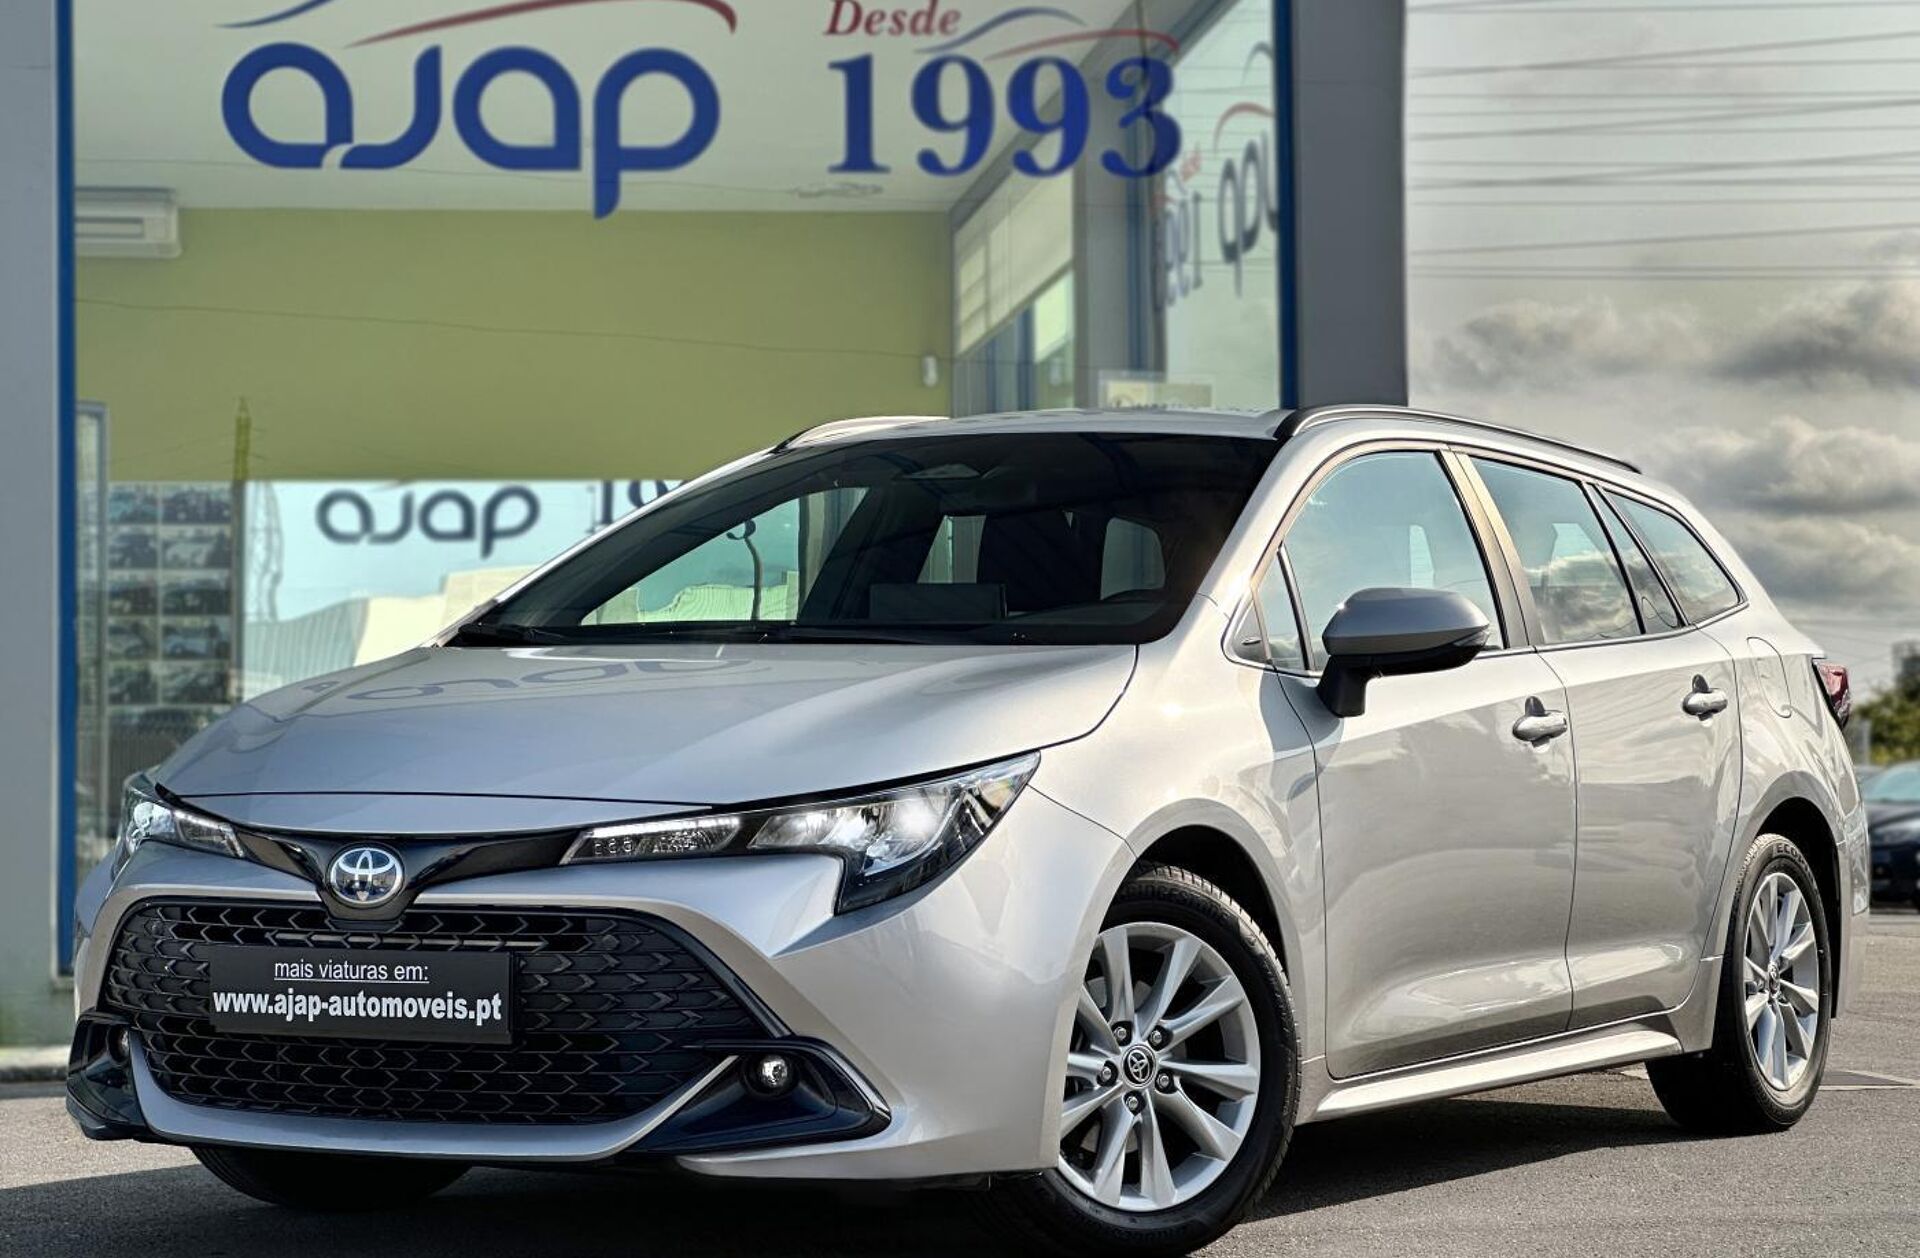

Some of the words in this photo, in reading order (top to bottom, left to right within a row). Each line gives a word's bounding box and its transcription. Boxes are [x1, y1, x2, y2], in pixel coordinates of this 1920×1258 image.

[824, 0, 961, 36] Desde
[827, 54, 1182, 178] 1993
[274, 959, 313, 978] mais
[319, 959, 388, 980] viaturas
[394, 964, 428, 981] em:
[212, 987, 502, 1026] www.ajap-automoveis.pt
